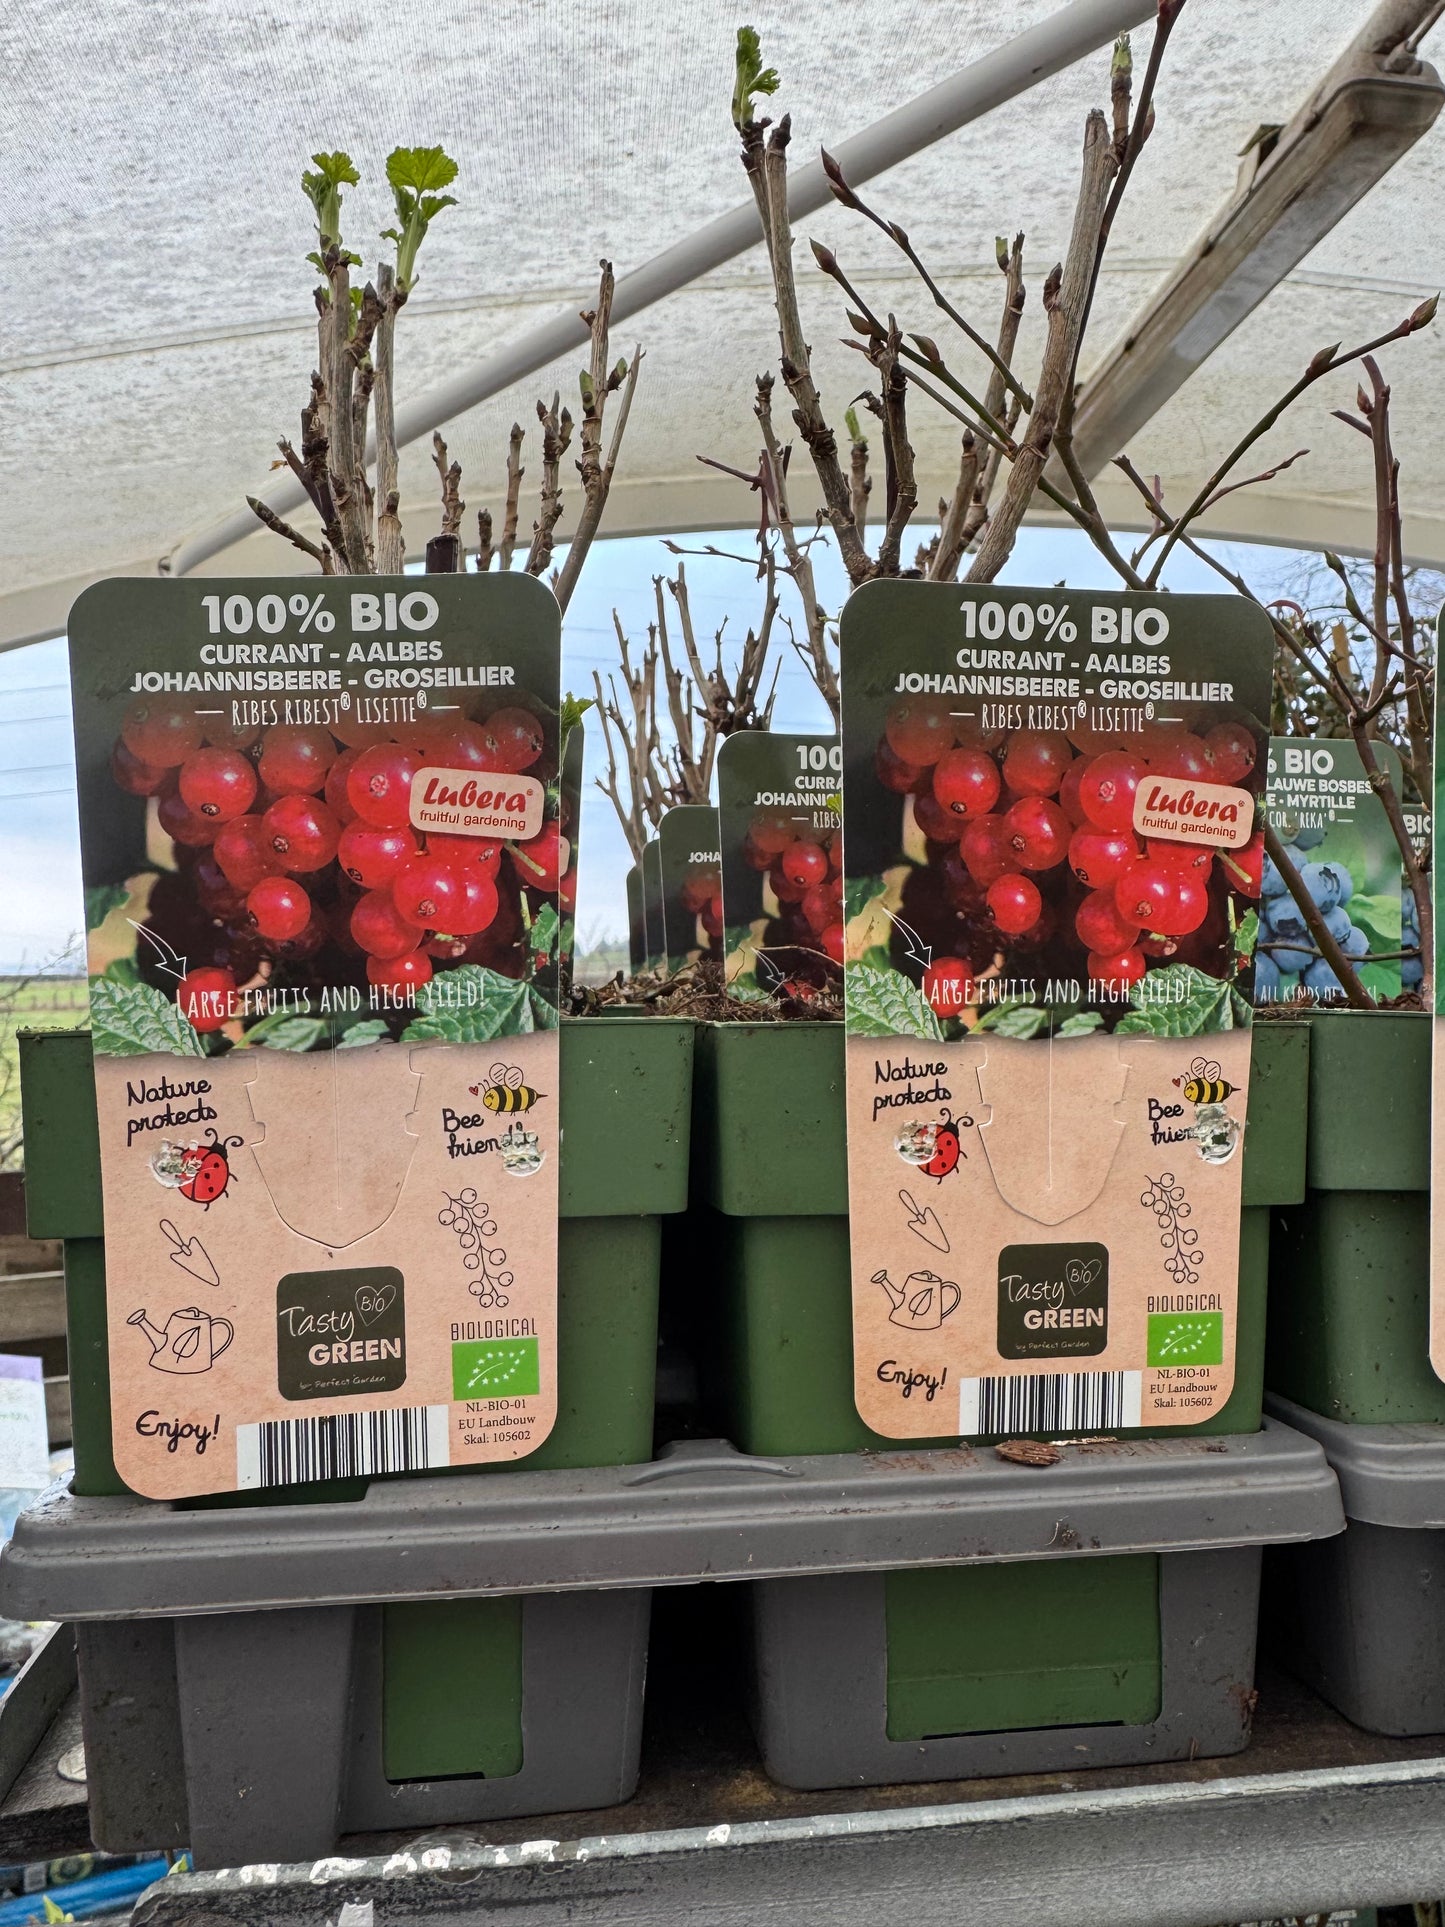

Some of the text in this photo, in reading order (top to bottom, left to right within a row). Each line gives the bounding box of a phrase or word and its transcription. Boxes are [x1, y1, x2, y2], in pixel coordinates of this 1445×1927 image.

[200, 590, 440, 634] 100% BIO
[959, 601, 1171, 646] 100% BIO
[200, 643, 323, 665] CURRANT
[347, 641, 443, 663] AALBES
[956, 649, 1065, 671] CURRANT
[1085, 653, 1171, 675] AALBES
[130, 670, 341, 693] JOHANNISBEERE
[363, 666, 515, 689] GROSEILLIER
[894, 673, 1080, 698] JOHANNISBEERE
[1100, 679, 1234, 702] GROSEILLIER
[231, 699, 278, 725] RIBES
[982, 703, 1022, 730] RIBES
[1284, 748, 1334, 775] BIO
[1318, 778, 1373, 794] BOSBES
[1287, 794, 1356, 809] MYRTILLE
[419, 810, 526, 832] fruitful gardening
[813, 811, 841, 829] RIBES
[1142, 815, 1237, 839] fruitful gardening
[176, 980, 487, 1020] LARGE FRUITS AND HIGH YIELD!
[921, 975, 1192, 1006] LARGE FRUITS AND HIGH YIELD!
[875, 1057, 948, 1084] Nature
[126, 1075, 212, 1106] Nature
[873, 1079, 952, 1121] protects
[442, 1108, 484, 1132] Bee
[1148, 1098, 1184, 1121] Bee
[127, 1098, 217, 1147] protects
[1070, 1268, 1092, 1284] BIO
[360, 1296, 385, 1312] BIO
[1000, 1274, 1065, 1310] Tasty
[1147, 1293, 1222, 1312] BIOLOGICAL
[279, 1306, 355, 1342] Tasty
[451, 1317, 538, 1341] BIOLOGICAL
[1023, 1307, 1104, 1330] GREEN
[308, 1337, 402, 1366] GREEN
[876, 1359, 948, 1401] Enjoy!
[1157, 1368, 1210, 1380] NL-BIO-01
[1150, 1382, 1218, 1394] EU Landbouw
[466, 1399, 526, 1413] NL-BIO-01
[1154, 1397, 1213, 1408] Skal: 105602
[135, 1409, 221, 1455] Enjoy!
[458, 1416, 536, 1430] EU Landbouw
[464, 1430, 531, 1446] Skal: 105602
